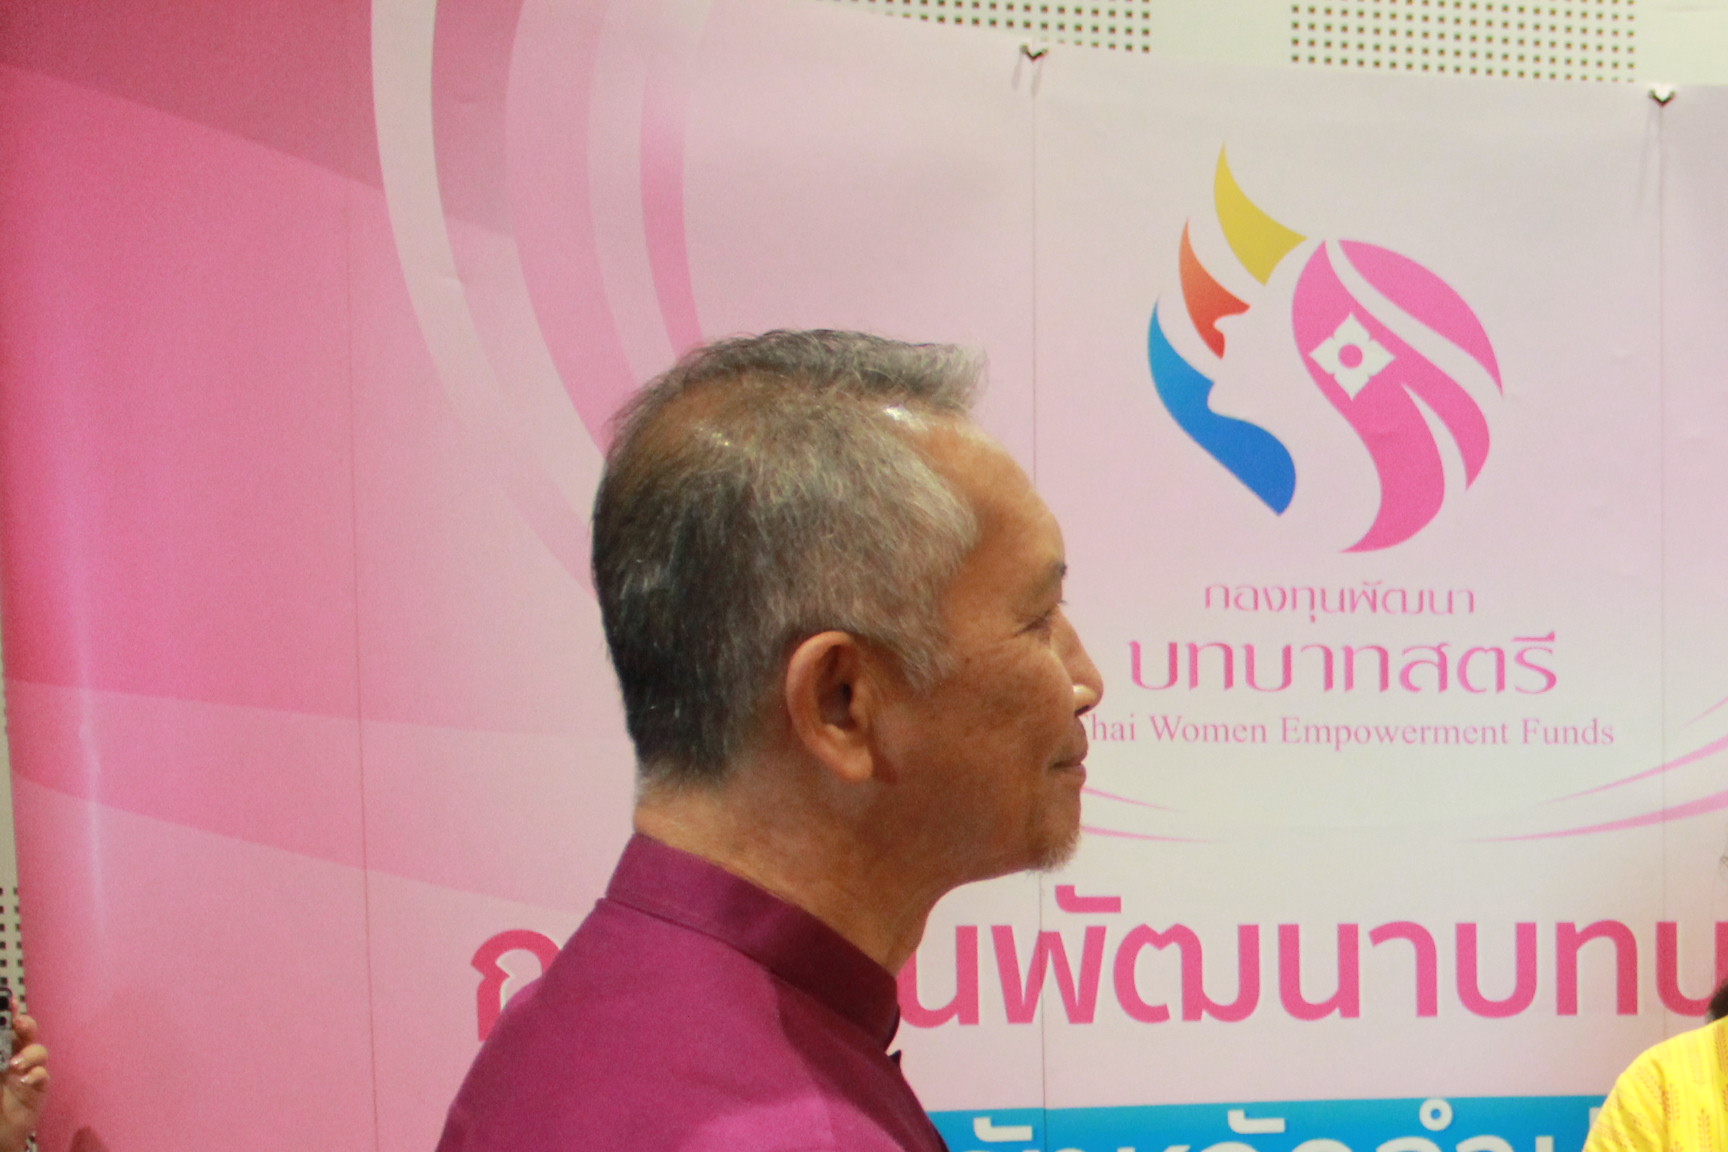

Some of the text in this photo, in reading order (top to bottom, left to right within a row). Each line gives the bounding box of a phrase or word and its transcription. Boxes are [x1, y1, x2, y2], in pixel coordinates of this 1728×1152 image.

[1203, 579, 1475, 624] กองทุนพัฒนา
[1128, 630, 1559, 695] บทบาทสตรี
[1086, 712, 1615, 753] hai Women Empowerment Funds
